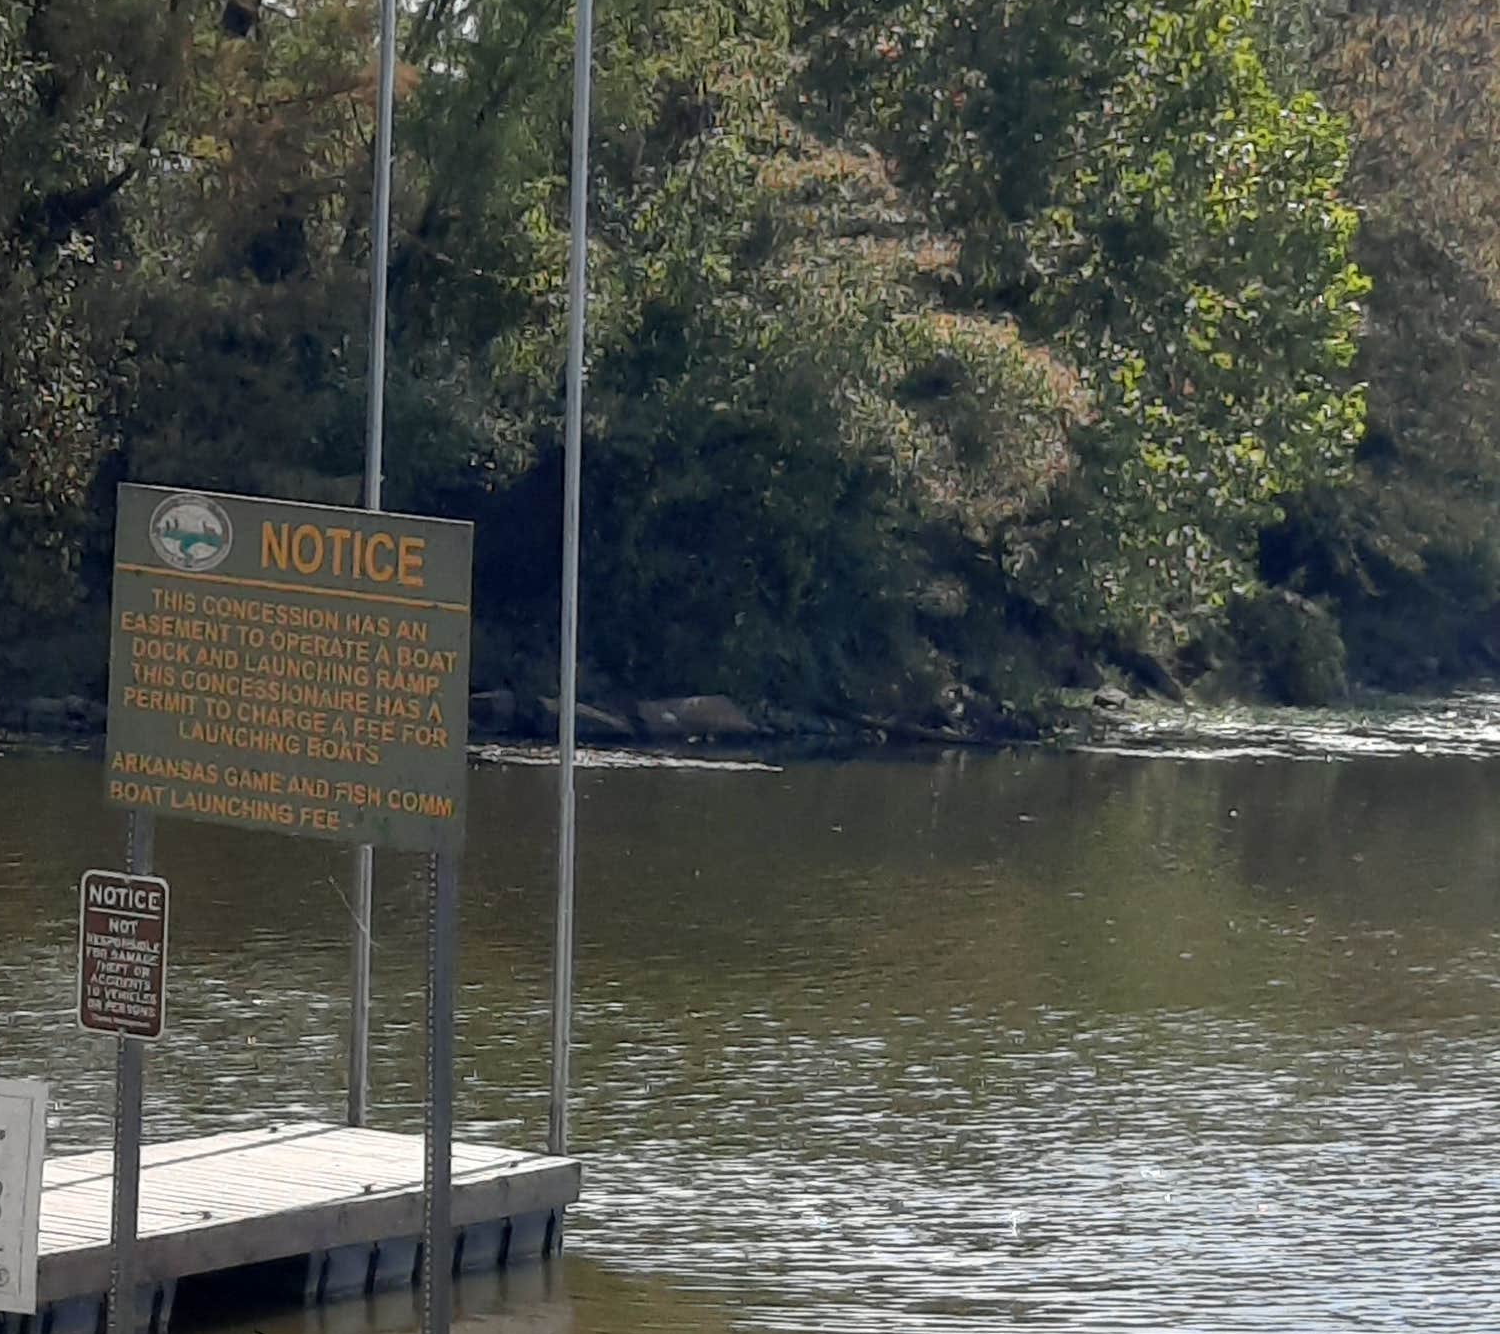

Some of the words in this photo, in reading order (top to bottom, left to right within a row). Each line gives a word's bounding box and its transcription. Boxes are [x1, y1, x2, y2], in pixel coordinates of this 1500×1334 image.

[260, 521, 426, 588] NOTICE
[120, 610, 232, 643] EASEMENT
[236, 624, 265, 648] TO
[270, 628, 371, 663] OPERATE
[374, 641, 391, 666] A
[397, 646, 458, 673] BOAT
[151, 588, 196, 613] THIS
[202, 595, 340, 632] CONCESSION
[346, 613, 392, 638] HAS
[396, 619, 428, 643] AN
[132, 636, 190, 664] DOCK
[195, 647, 239, 669] AND
[244, 652, 370, 687] LAUNCHING
[123, 686, 198, 715] PERMIT
[204, 697, 232, 720] TO
[237, 702, 328, 734] CHARGE
[331, 717, 347, 739] A
[353, 717, 397, 742] FEE
[402, 723, 449, 748] FOR
[131, 662, 175, 688] THIS
[181, 670, 370, 715] CONCESSIONAIRE
[375, 696, 421, 719] HAS
[427, 701, 443, 724] A
[179, 719, 300, 755] LAUNCHING
[307, 736, 381, 765] BOATS
[109, 779, 167, 806] BOAT
[171, 788, 294, 825] LAUNCHING
[300, 807, 341, 831] FEE
[111, 750, 219, 785] ARKANSAS
[224, 765, 285, 795] GAME
[287, 776, 331, 799] AND
[333, 781, 381, 808] FISH
[388, 788, 455, 819] COMM
[88, 883, 162, 911] NOTICE
[108, 917, 139, 934] NOT
[86, 984, 101, 997] TO
[95, 959, 130, 976] THEFT
[133, 966, 151, 979] OR
